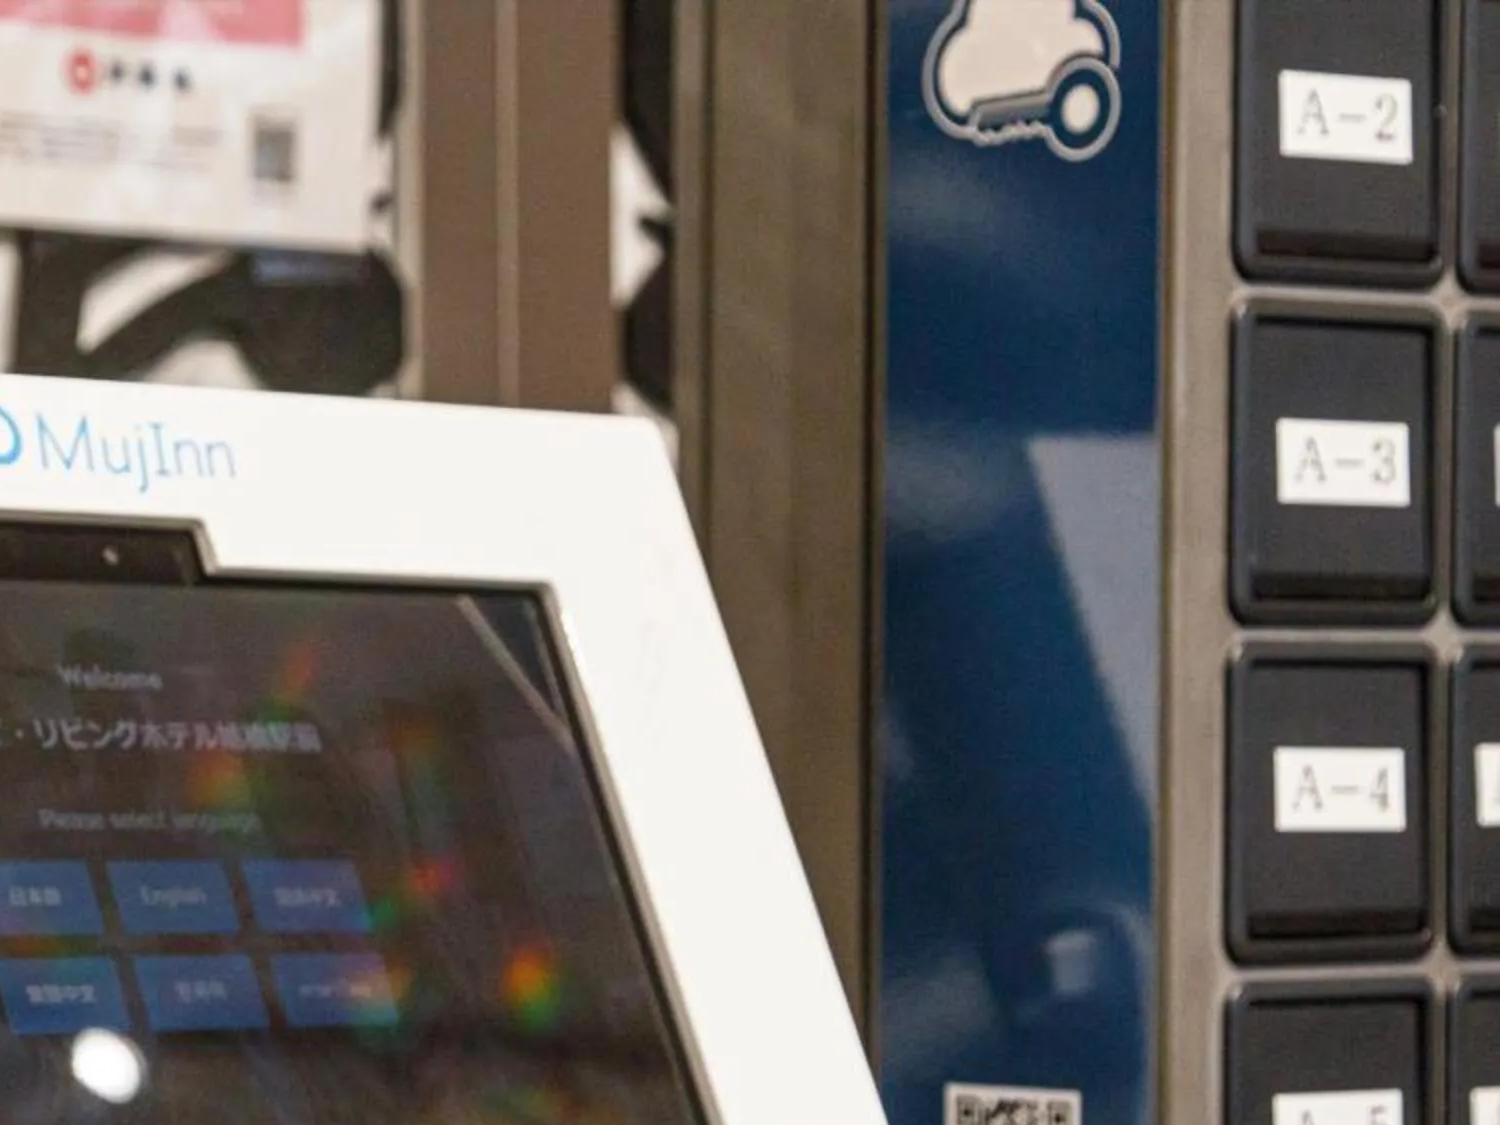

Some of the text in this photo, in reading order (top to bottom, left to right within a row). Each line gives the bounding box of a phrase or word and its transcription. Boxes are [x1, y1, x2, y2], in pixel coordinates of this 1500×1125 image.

[1296, 88, 1399, 143] A-2
[34, 411, 238, 494] MujInn
[1293, 434, 1398, 488] A-3
[55, 664, 164, 692] Welcome
[1291, 761, 1390, 814] A-4
